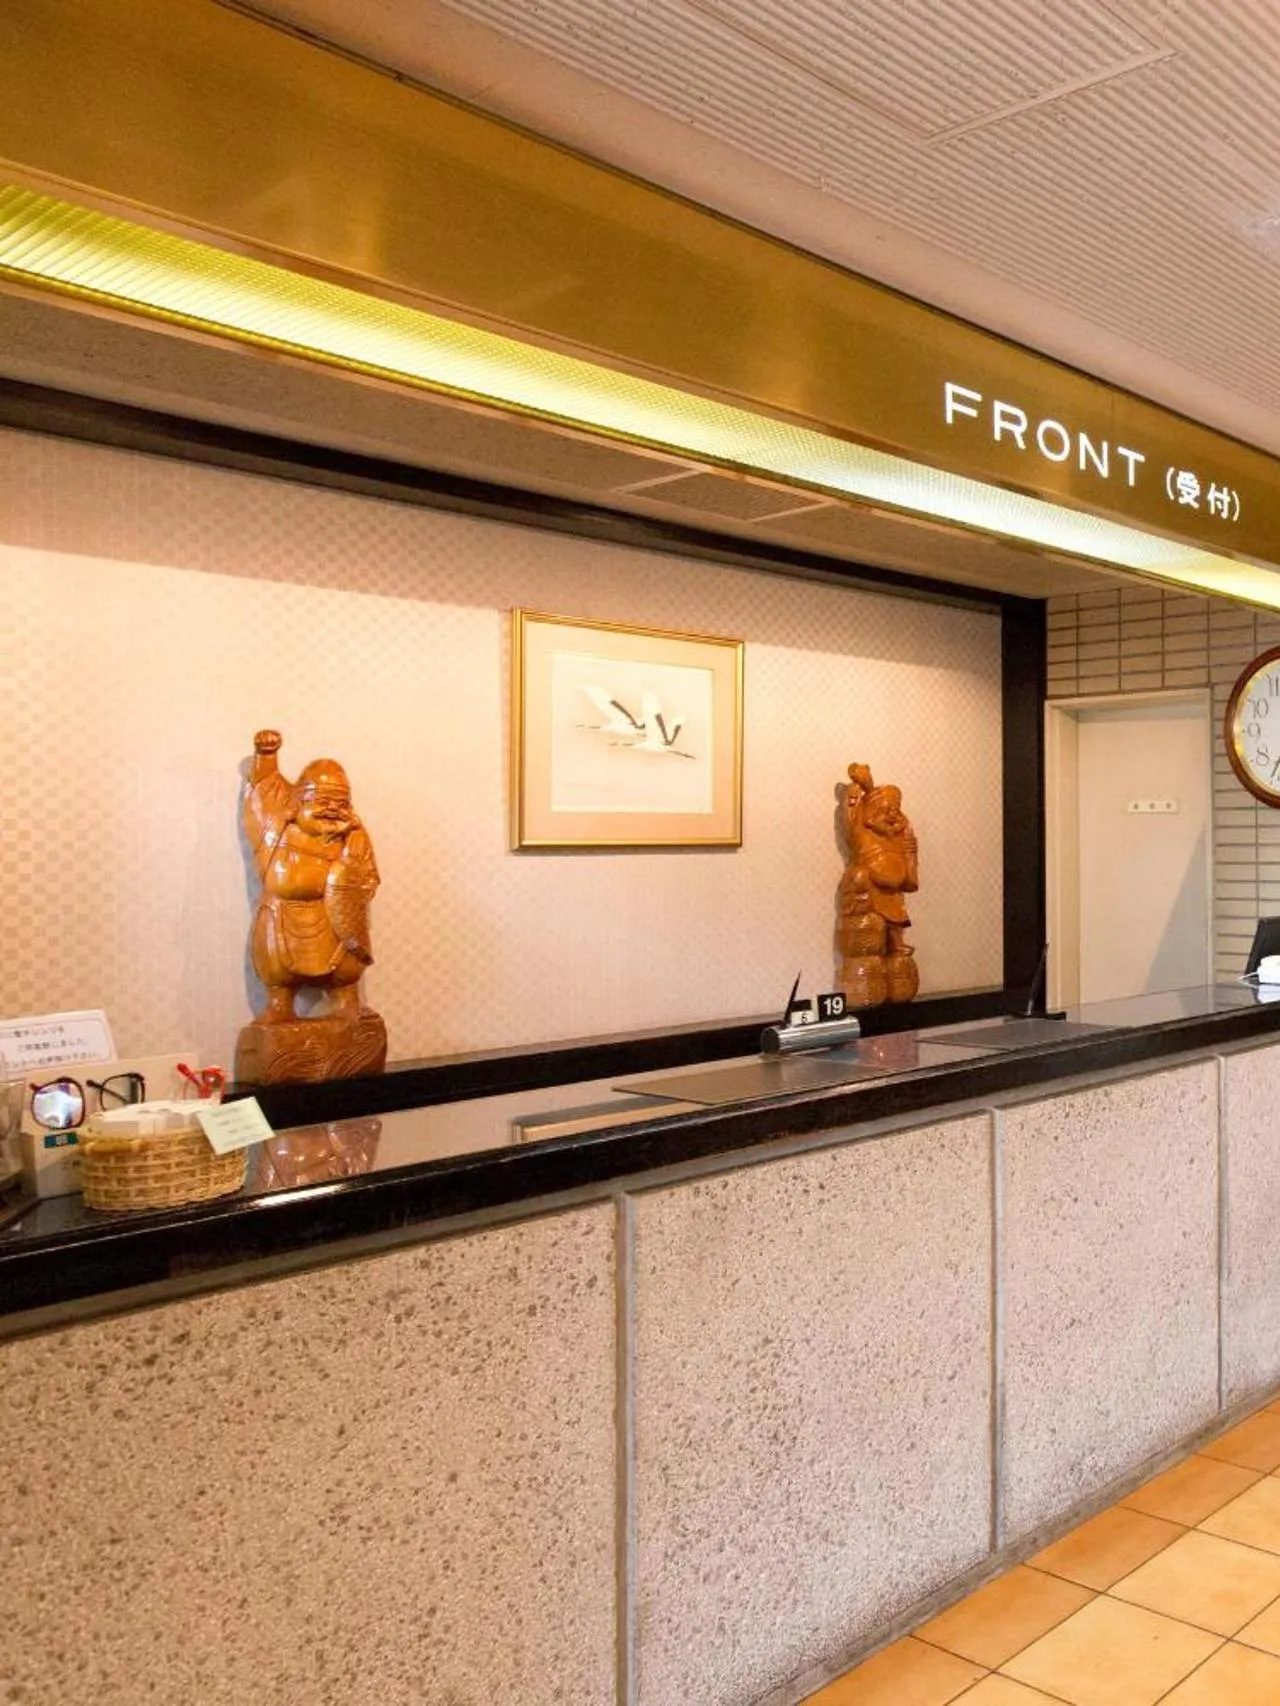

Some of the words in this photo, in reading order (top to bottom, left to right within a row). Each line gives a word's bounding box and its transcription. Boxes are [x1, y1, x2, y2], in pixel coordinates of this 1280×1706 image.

[944, 381, 1145, 487] FRONT
[1166, 467, 1240, 522] (受付)
[1267, 674, 1279, 697] 11
[1247, 697, 1269, 719] 10
[1255, 745, 1270, 767] 8
[823, 996, 844, 1016] 19
